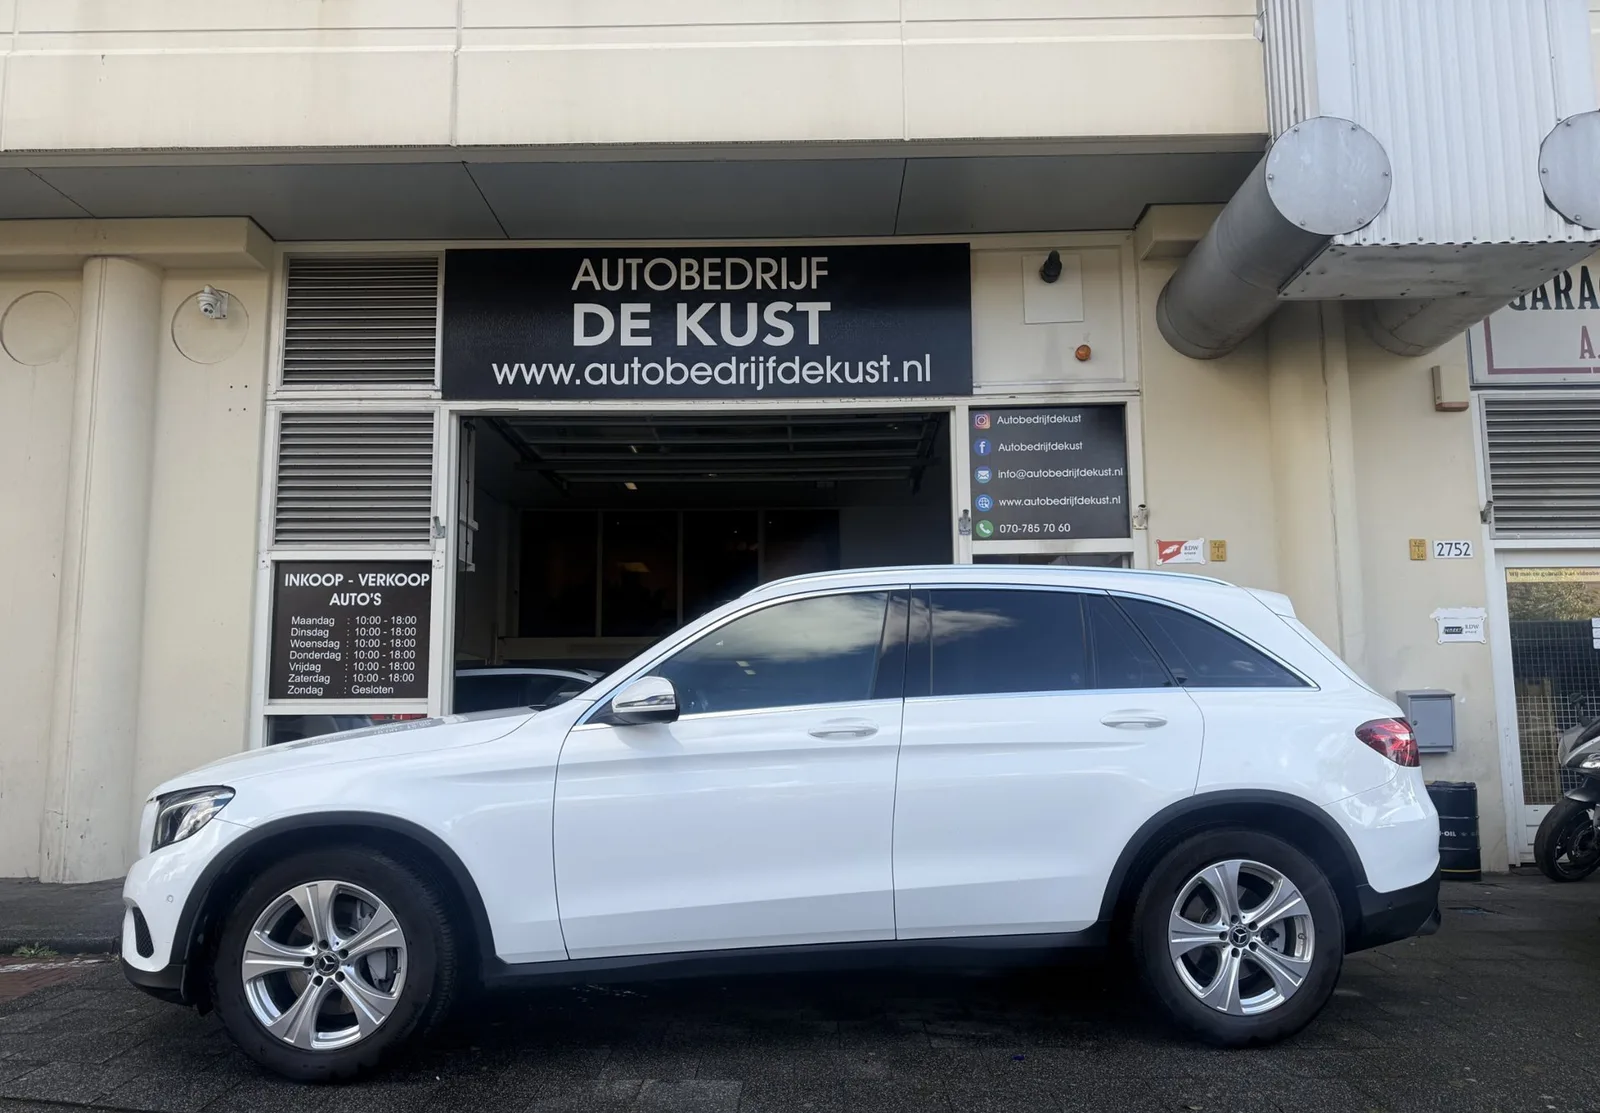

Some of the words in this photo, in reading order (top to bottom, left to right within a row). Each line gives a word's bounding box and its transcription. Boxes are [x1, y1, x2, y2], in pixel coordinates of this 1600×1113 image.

[571, 256, 829, 291] AUTOBEDRIJF
[573, 303, 653, 347] DE
[676, 301, 831, 347] KUST
[492, 353, 931, 391] www.autobedrijfdekust.nl
[996, 413, 1082, 427] Autobedrijfdekust
[998, 440, 1083, 454] Autobedrijfdekust
[998, 495, 1121, 508] www.autobedrijfdekust.nl
[999, 523, 1040, 534] 070-785
[1043, 523, 1056, 533] 70
[1058, 522, 1071, 533] 60
[1436, 542, 1471, 557] 2752
[284, 573, 344, 587] INKOOP
[358, 573, 430, 587] VERKOOP
[329, 592, 382, 606] AUTO'S
[291, 615, 335, 626] Maandag
[355, 615, 381, 625] 10:00
[391, 615, 417, 625] 18:00
[290, 627, 330, 638] Dinsdag
[355, 627, 381, 637] 10:00
[391, 627, 417, 637] 18:00
[289, 639, 340, 650] Woensdag
[354, 638, 380, 648] 10:00
[390, 638, 416, 648] 18:00
[289, 650, 342, 661] Donderdag
[353, 650, 379, 660] 10:00
[389, 650, 415, 660] 18:00
[288, 661, 322, 673] Vrijdag
[353, 661, 379, 671] 10:00
[389, 661, 415, 671] 18:00
[287, 673, 331, 684] Zaterdag
[352, 673, 378, 683] 10:00
[388, 673, 414, 683] 18:00
[287, 685, 324, 696] Zondag
[351, 684, 394, 695] Gesloten
